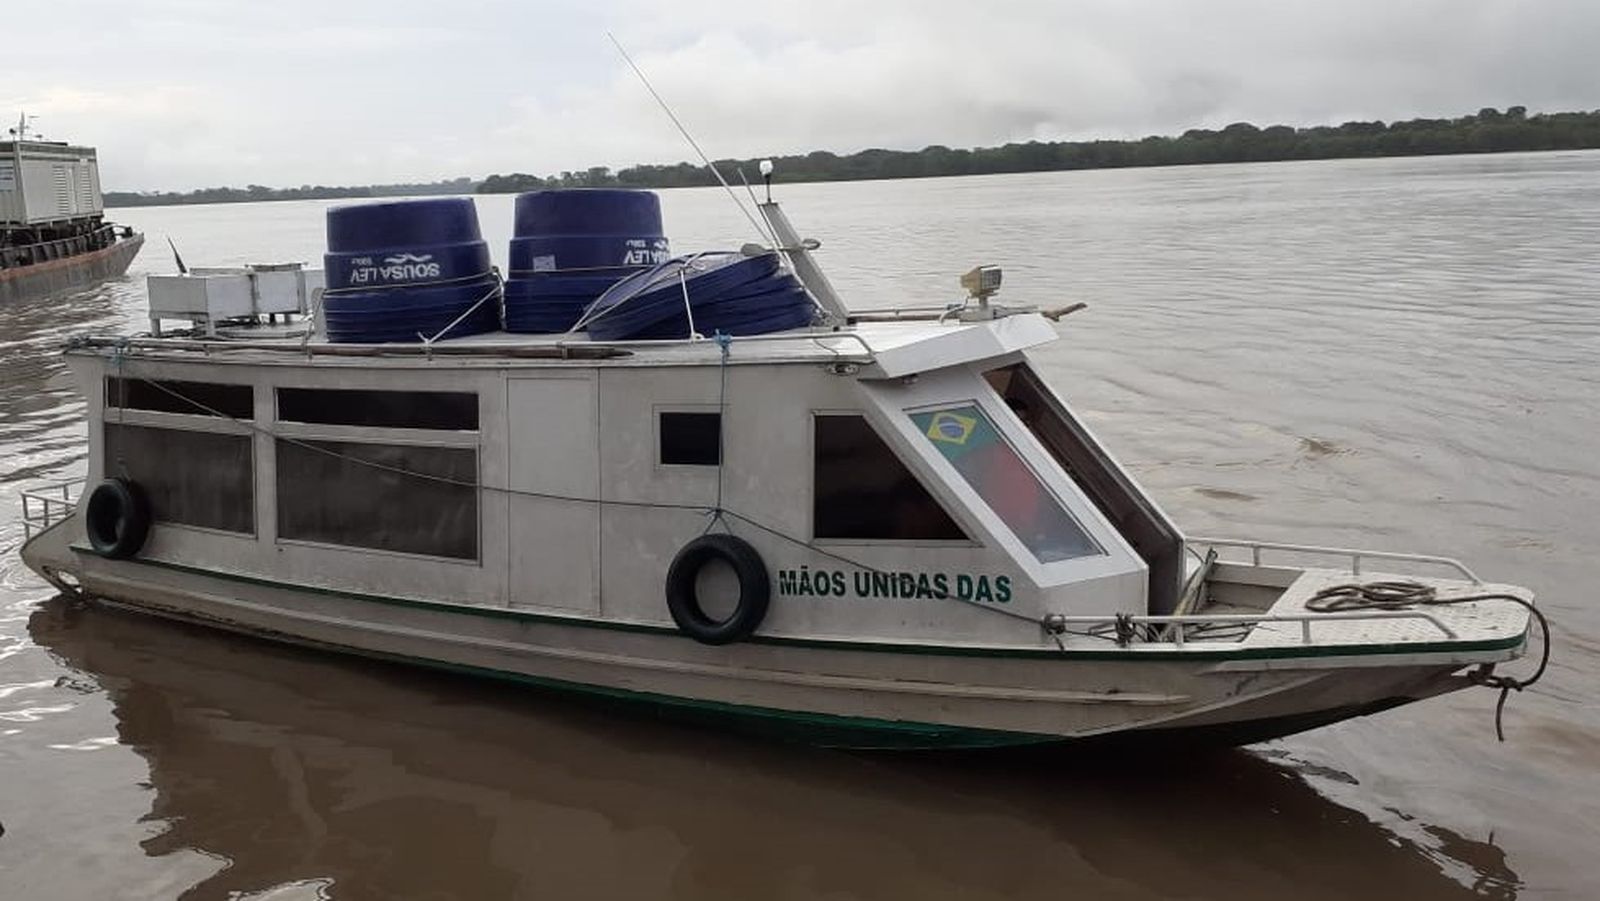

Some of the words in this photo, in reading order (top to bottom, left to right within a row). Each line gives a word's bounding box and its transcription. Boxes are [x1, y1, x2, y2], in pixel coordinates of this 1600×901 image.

[623, 250, 650, 265] LEV
[350, 267, 378, 283] LEV
[379, 262, 440, 280] SOUSA
[778, 565, 846, 596] MÃOS
[853, 572, 949, 600] UNIDAS
[956, 574, 1012, 603] DAS
